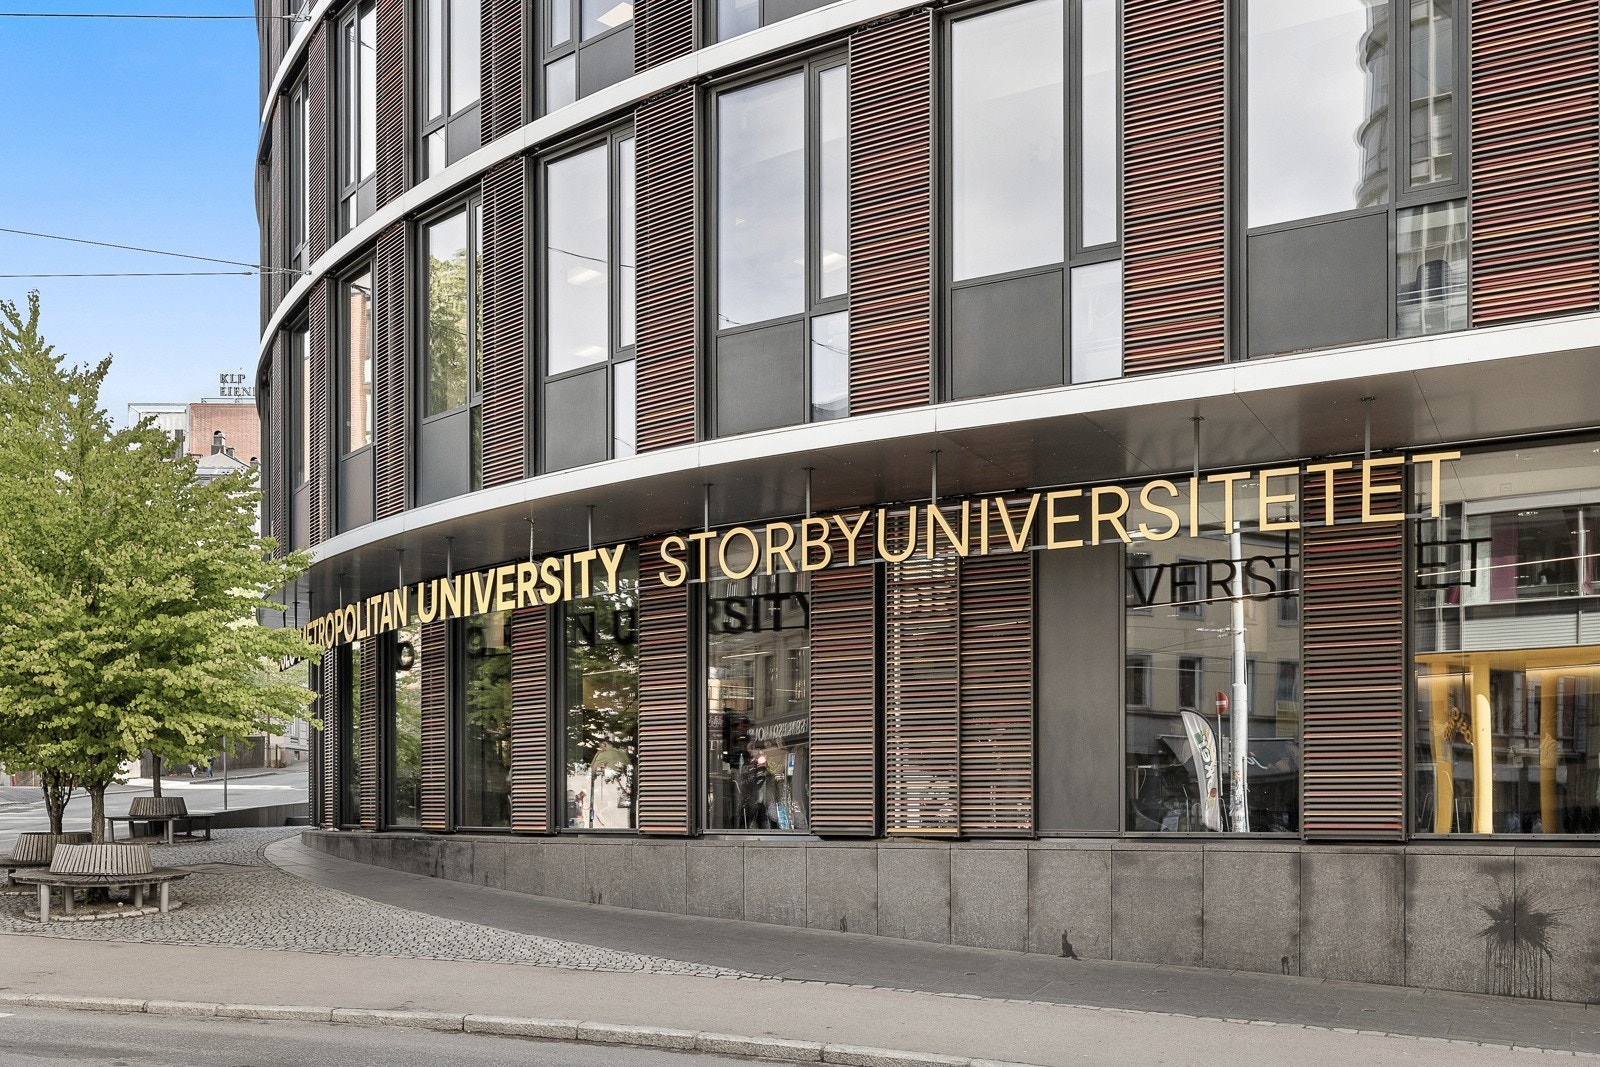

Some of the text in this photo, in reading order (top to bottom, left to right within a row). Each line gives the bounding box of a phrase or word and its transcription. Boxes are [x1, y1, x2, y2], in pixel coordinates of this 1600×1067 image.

[220, 373, 246, 384] KLP
[659, 450, 1462, 588] STORBYUNIVERSITETET
[416, 544, 625, 623] UNIVERSITY
